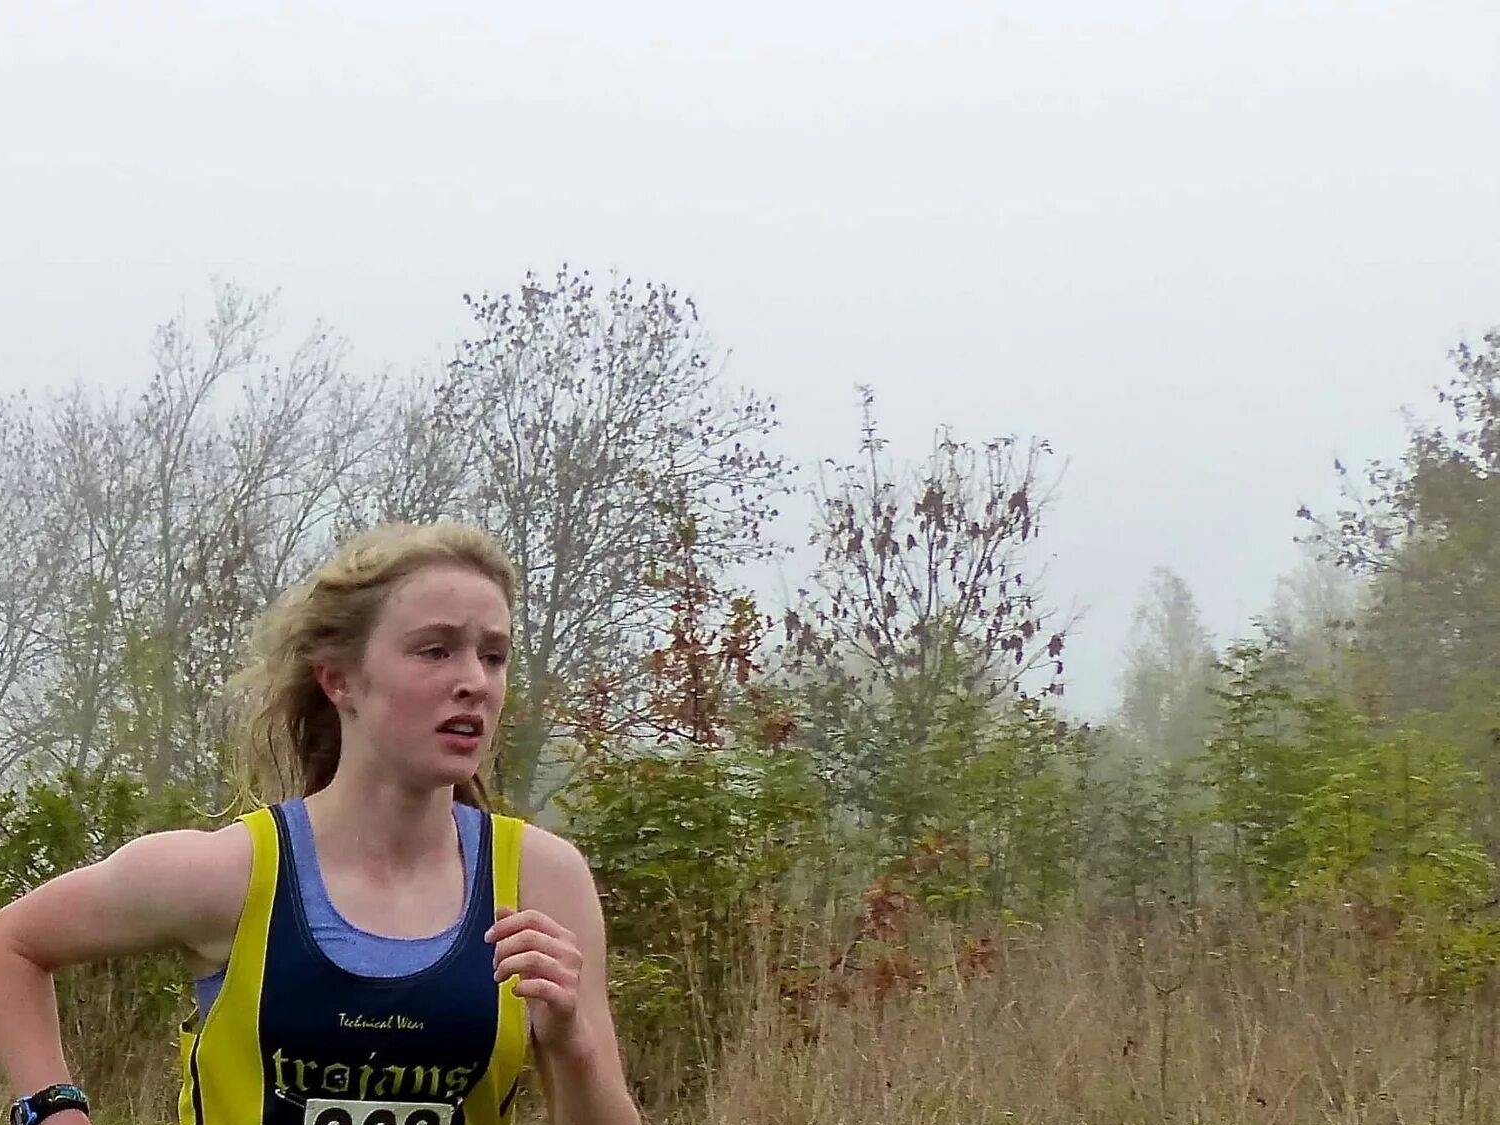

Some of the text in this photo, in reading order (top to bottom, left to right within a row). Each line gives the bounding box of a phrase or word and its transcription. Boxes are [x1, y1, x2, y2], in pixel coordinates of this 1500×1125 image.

[338, 1012, 424, 1030] Technical Wear
[272, 1048, 479, 1101] trojans
